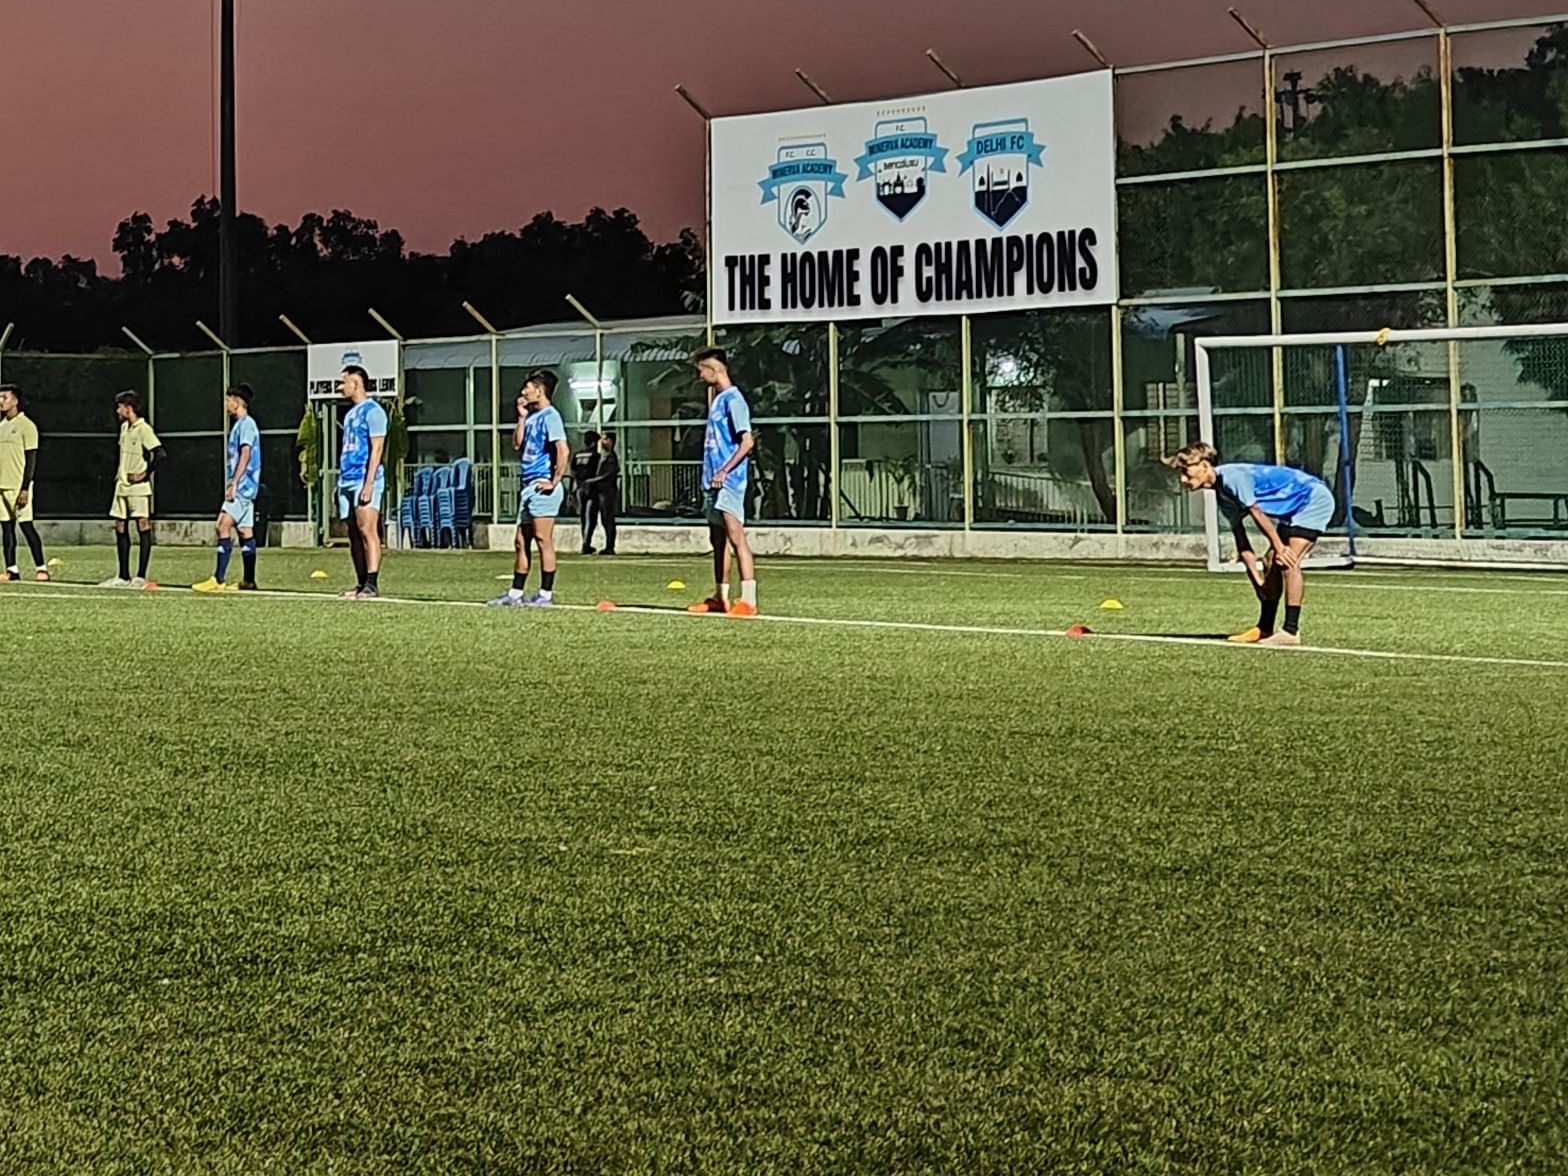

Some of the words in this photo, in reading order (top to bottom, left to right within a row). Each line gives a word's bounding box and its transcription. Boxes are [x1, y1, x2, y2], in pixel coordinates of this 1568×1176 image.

[976, 136, 1006, 155] DELHI
[1010, 135, 1025, 151] FC
[725, 254, 771, 311] THE
[780, 248, 861, 310] HOME
[870, 245, 904, 305] OF
[915, 227, 1098, 303] CHAMPIONS
